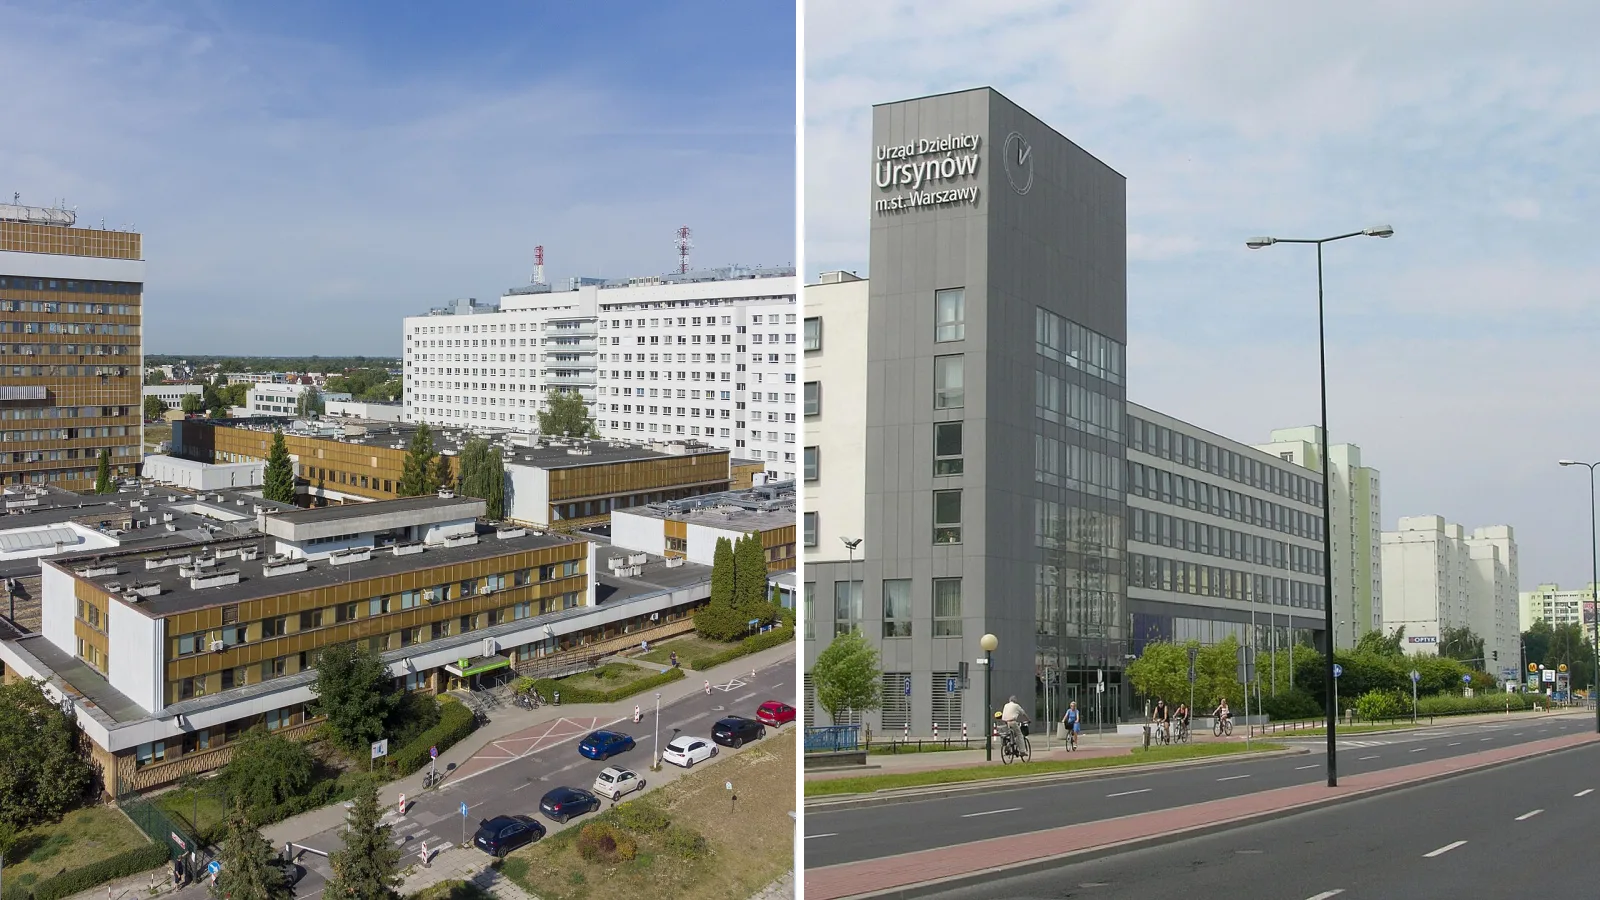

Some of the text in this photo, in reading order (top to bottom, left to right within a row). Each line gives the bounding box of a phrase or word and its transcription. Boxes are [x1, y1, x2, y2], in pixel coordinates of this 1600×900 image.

[876, 133, 979, 160] Urząd Dzielnicy
[876, 151, 978, 189] Ursynów
[875, 186, 978, 211] m.st. Warszawy
